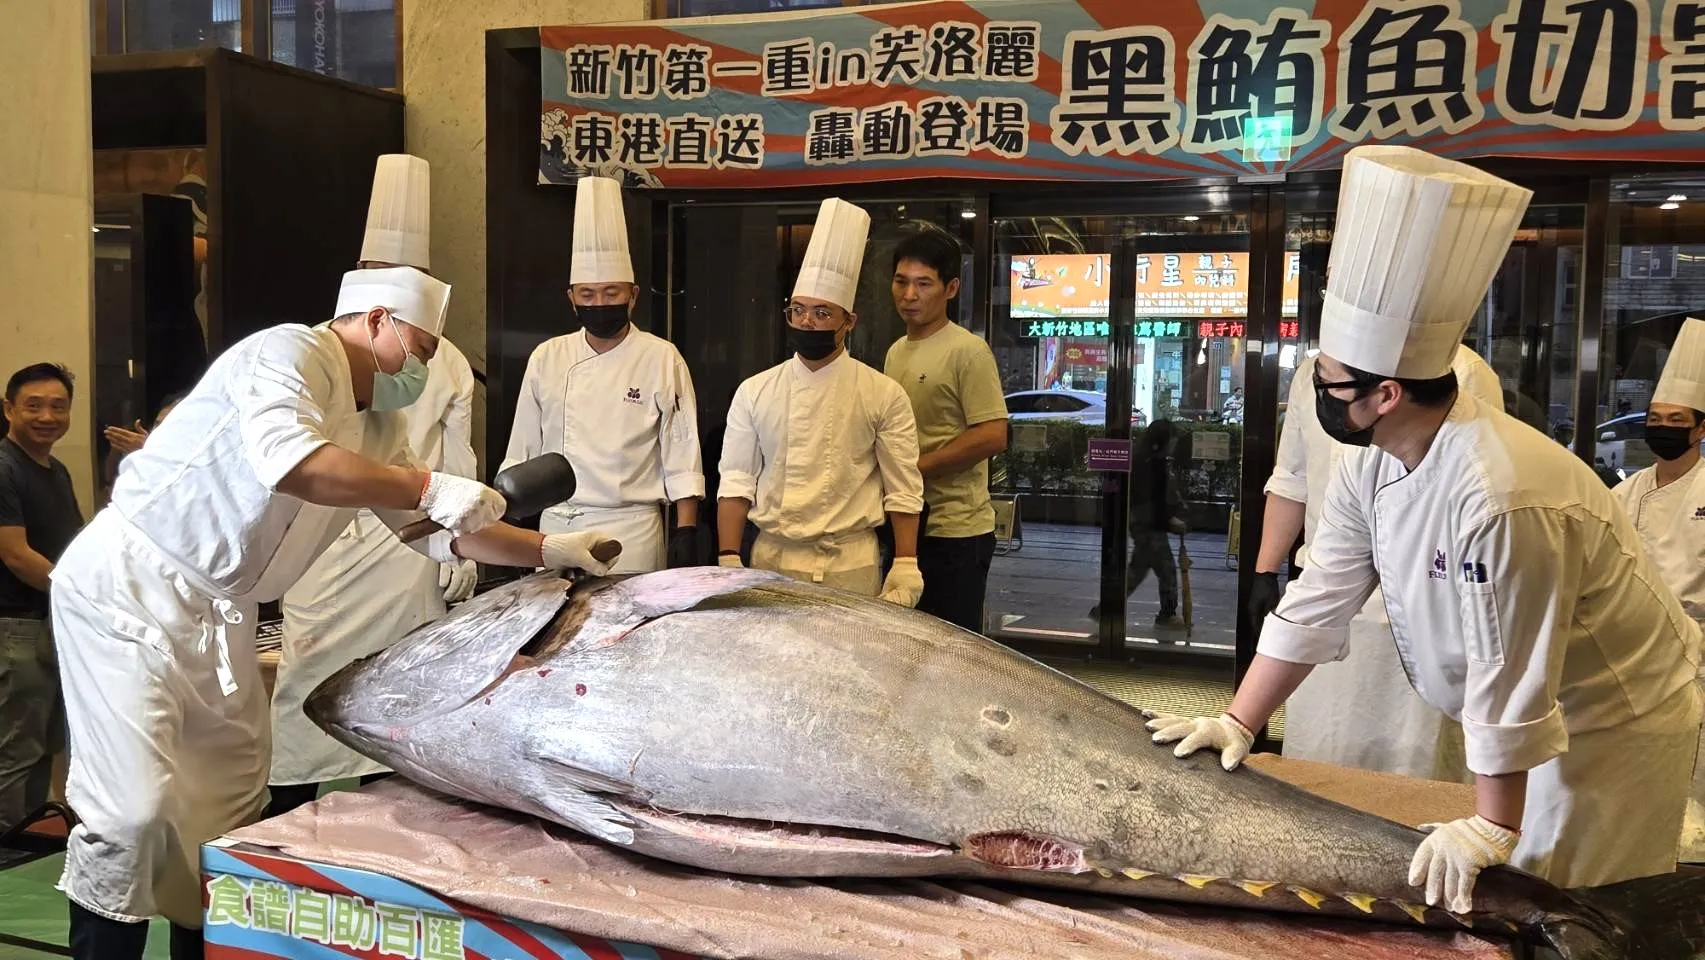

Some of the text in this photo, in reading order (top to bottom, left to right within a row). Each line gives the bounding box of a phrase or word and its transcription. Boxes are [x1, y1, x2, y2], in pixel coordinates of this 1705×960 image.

[314, 0, 326, 76] YOKOHA
[570, 26, 1038, 96] 新竹第一重in芙洛麗
[574, 99, 1026, 166] 東港直送 轟動登場
[207, 876, 464, 959] 食譜自助百匯
